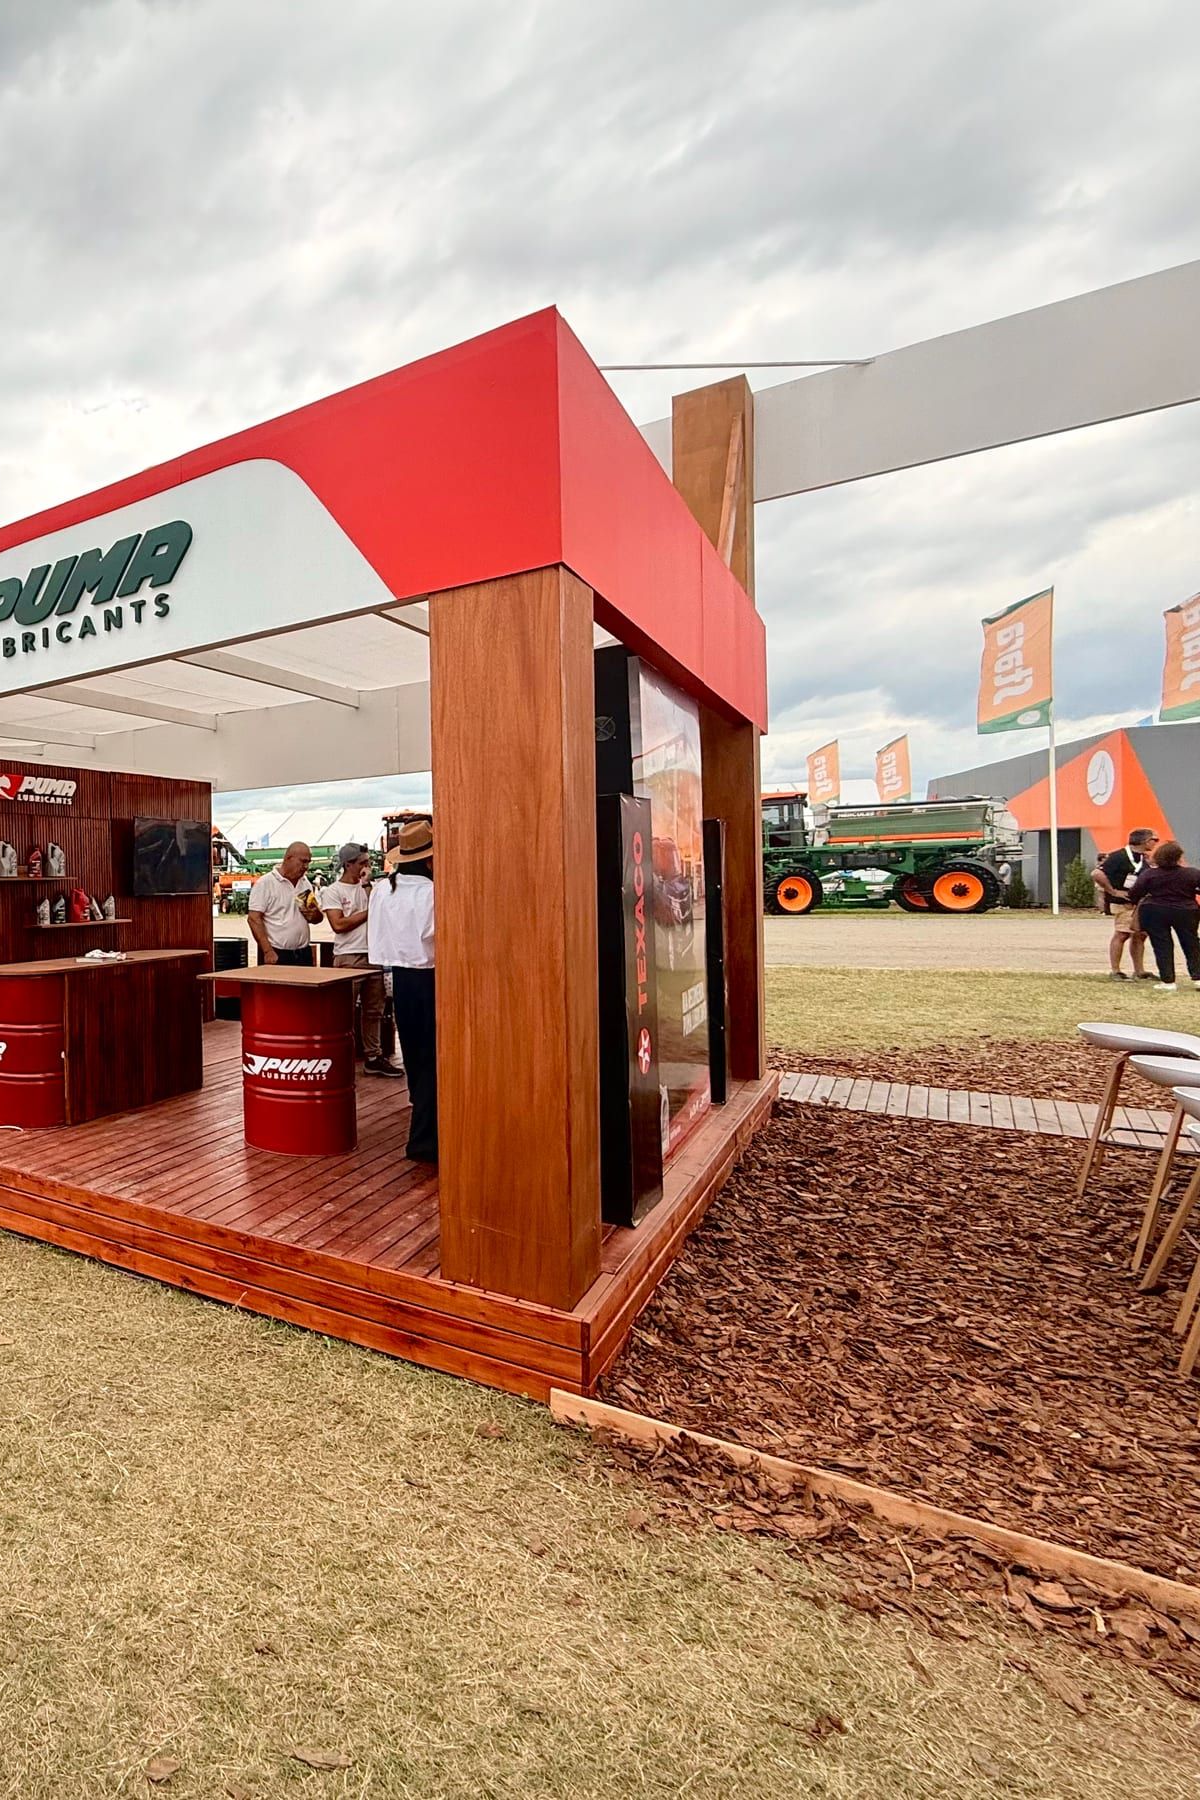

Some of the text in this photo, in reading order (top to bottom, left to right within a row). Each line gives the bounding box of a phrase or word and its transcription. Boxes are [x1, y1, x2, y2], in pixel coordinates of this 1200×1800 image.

[18, 776, 77, 797] PUMA
[17, 793, 72, 805] LUBRICANTS
[633, 831, 648, 1016] TEXACO
[262, 1058, 332, 1074] PUMA
[261, 1071, 327, 1081] LUBRICANTS
